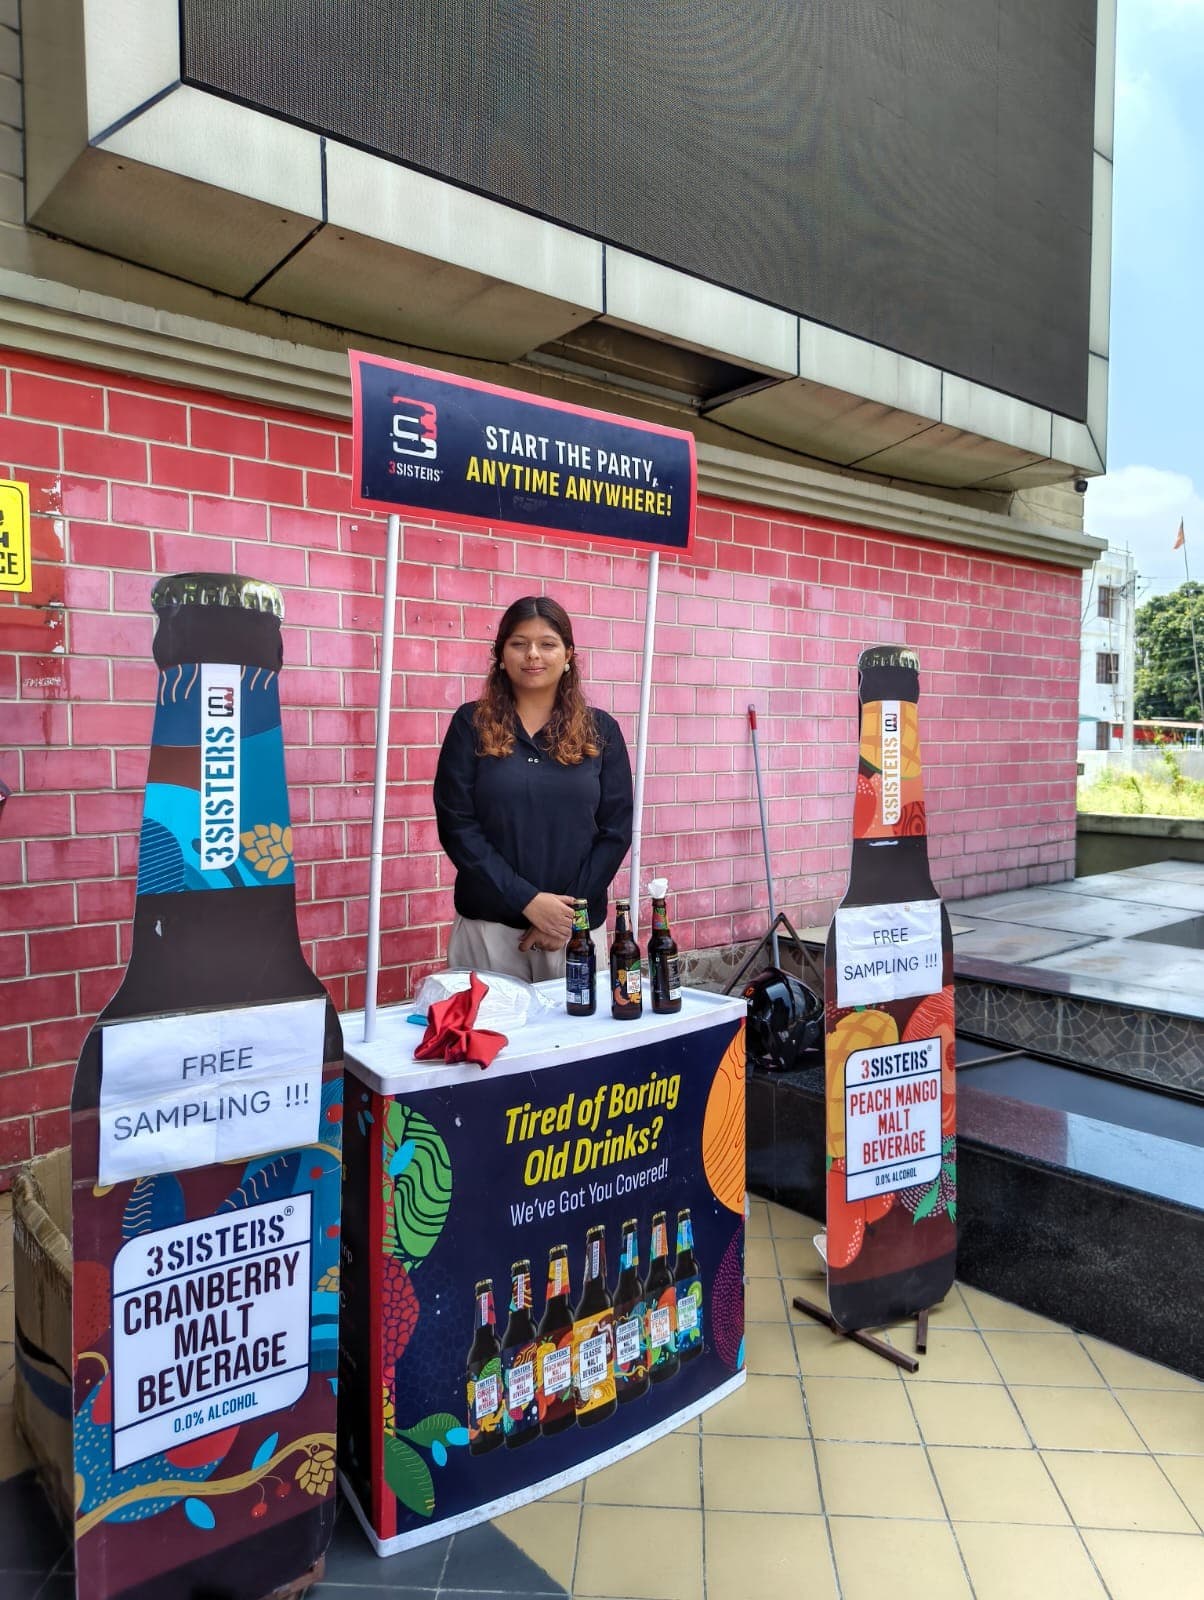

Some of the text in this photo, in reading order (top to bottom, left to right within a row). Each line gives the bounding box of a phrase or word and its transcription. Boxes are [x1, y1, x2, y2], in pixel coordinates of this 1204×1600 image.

[486, 425, 548, 461] START
[555, 440, 591, 470] THE
[466, 456, 672, 516] ANYTIME ANYWHERE!
[205, 726, 234, 863] 3SISTERS
[884, 737, 898, 821] 3SISTERS
[873, 927, 909, 946] FREE
[844, 953, 938, 982] SAMPLING !!!
[182, 1046, 254, 1080] FREE
[113, 1082, 309, 1141] SAMPLING !!!
[505, 1071, 681, 1145] Tired of Boring
[850, 1078, 938, 1116] PEACH MANGO
[878, 1108, 911, 1136] MALT
[523, 1115, 664, 1187] Old Drinks?
[863, 1129, 926, 1165] BEVERAGE
[510, 1158, 669, 1227] We've Got You Covered!
[875, 1167, 917, 1187] 0.0% ALCOHOL
[123, 1250, 300, 1336] CRANBERRY
[174, 1302, 254, 1360] MALT
[137, 1331, 287, 1414] BEVERAGE
[174, 1391, 258, 1433] 0.0% ALCOHOL
